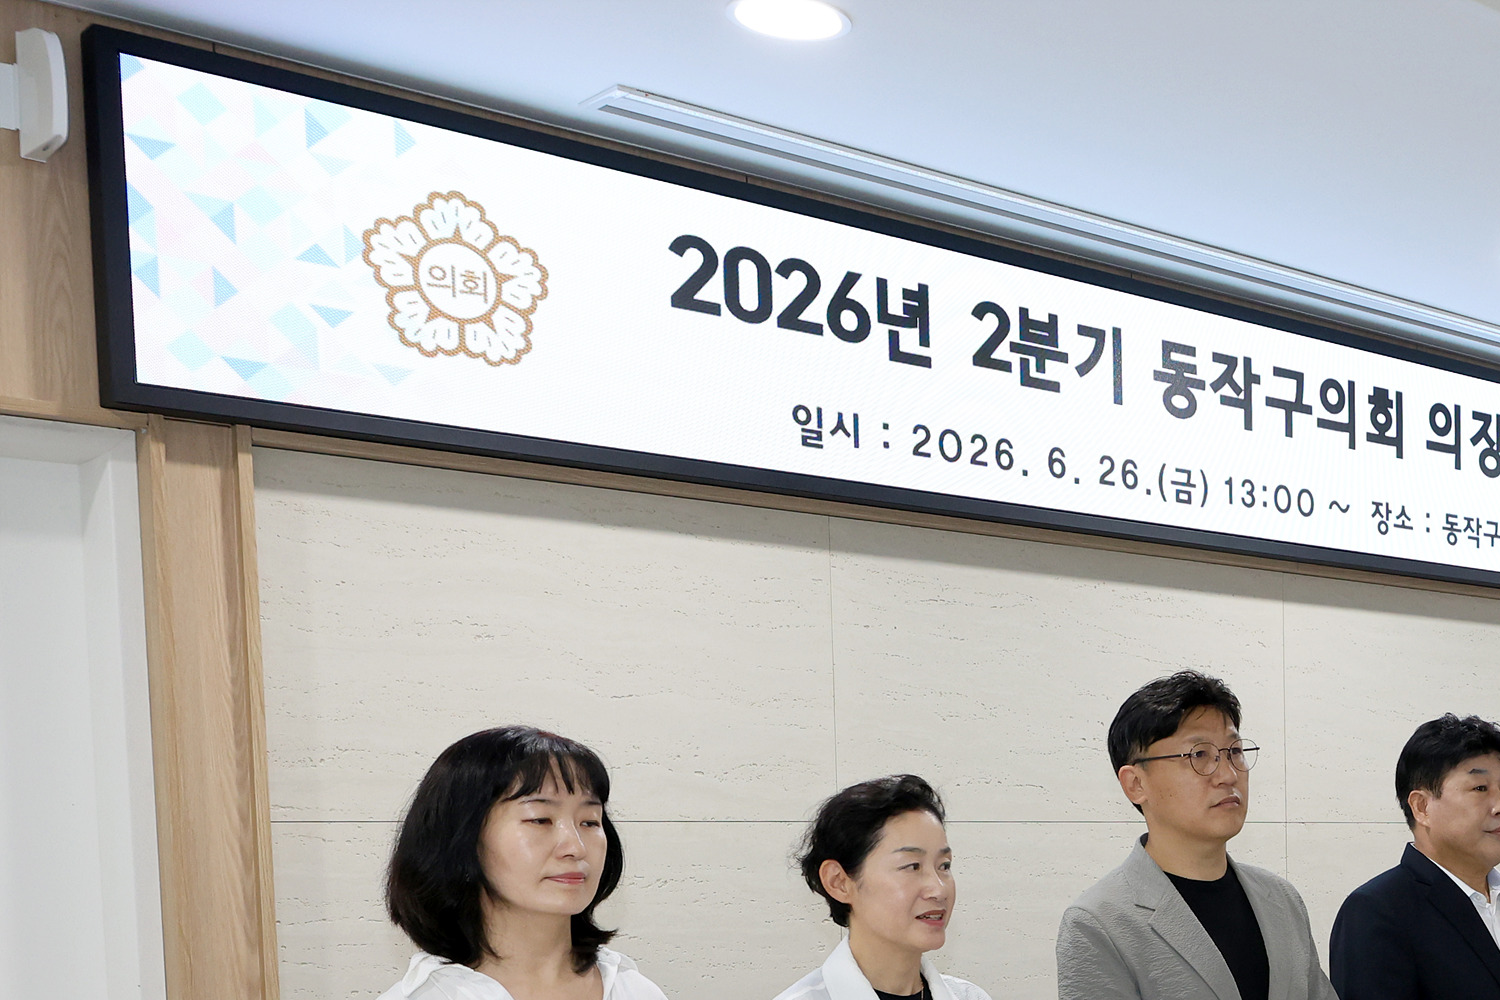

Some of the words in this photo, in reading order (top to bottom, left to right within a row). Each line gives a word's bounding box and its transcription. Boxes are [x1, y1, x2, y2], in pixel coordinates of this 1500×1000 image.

[428, 265, 488, 303] 의회
[668, 234, 932, 369] 2026년
[970, 300, 1123, 406] 2분기
[1153, 339, 1404, 460] 동작구의회
[791, 404, 860, 450] 일시
[912, 423, 1028, 477] 2026.
[1047, 446, 1080, 485] 6.
[1099, 455, 1208, 508] 26.(금)
[1224, 476, 1315, 518] 13:00
[1371, 501, 1414, 536] 장소
